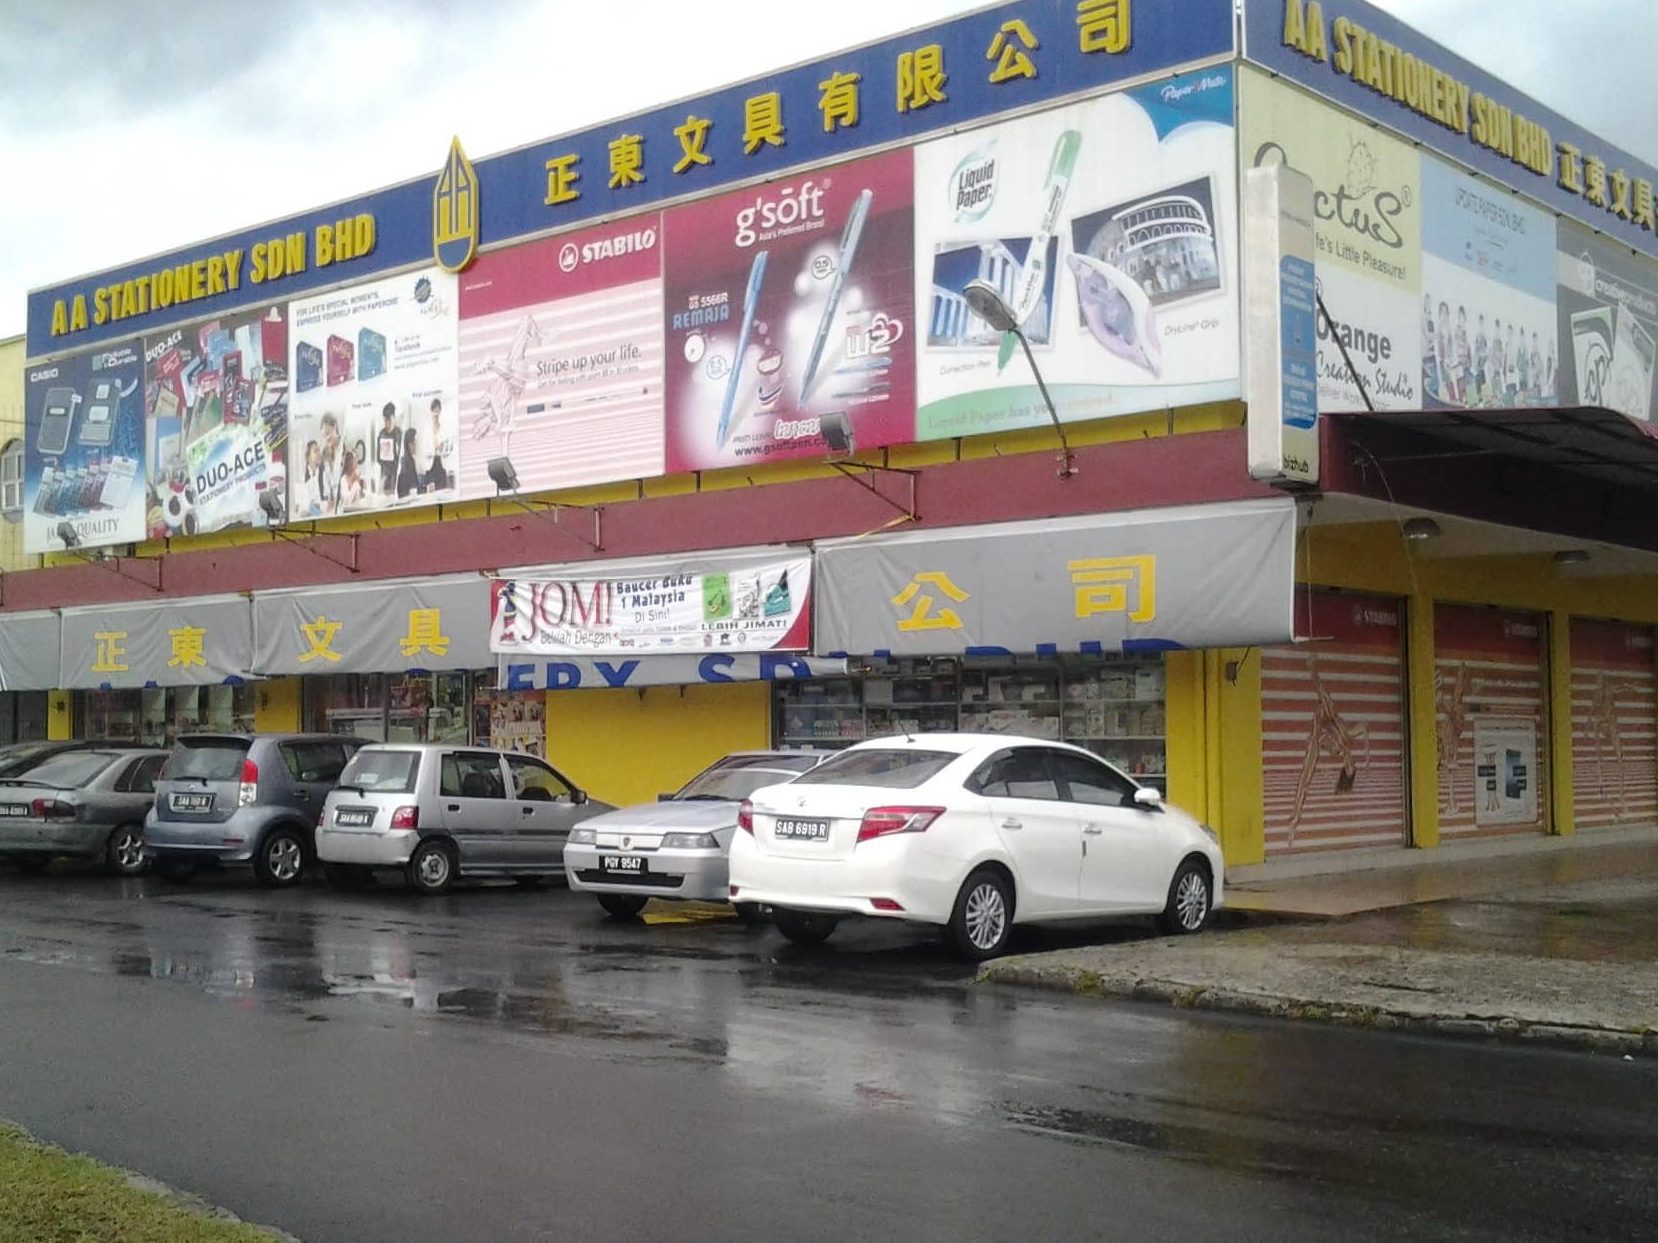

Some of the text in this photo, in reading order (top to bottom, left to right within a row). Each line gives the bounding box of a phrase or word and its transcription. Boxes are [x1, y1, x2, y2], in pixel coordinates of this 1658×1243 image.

[544, 0, 1132, 205] 正東文具有限公司
[1333, 16, 1470, 134] STATIONERY
[1471, 92, 1513, 159] SDN
[1513, 114, 1551, 177] BHD
[958, 159, 995, 191] Liquid
[1557, 140, 1658, 236] 正東文具
[582, 229, 657, 264] STABILO
[1335, 238, 1361, 265] Little
[94, 250, 243, 325] STATIONERY
[250, 232, 307, 284] SDN
[315, 213, 376, 267] BHD
[672, 304, 730, 330] REMAJA
[146, 330, 183, 362] DUO-ACE
[537, 358, 570, 377] Stripe
[572, 357, 589, 373] up
[589, 350, 617, 369] your
[619, 344, 643, 361] life.
[1375, 367, 1413, 401] Studio
[734, 438, 829, 457] www.gsoftpen.co
[196, 440, 266, 495] DUO-ACE
[76, 518, 121, 541] QUALITY
[616, 574, 693, 595] Baucer Buku
[631, 591, 685, 609] Malaysia
[892, 553, 1158, 632] 公司
[521, 579, 613, 642] JOM!
[634, 608, 670, 624] Di Sini!
[701, 621, 739, 632] LEBIH
[743, 619, 788, 631] JIMAT!
[574, 631, 612, 649] Dengan
[776, 821, 827, 837] SAB 6919 R
